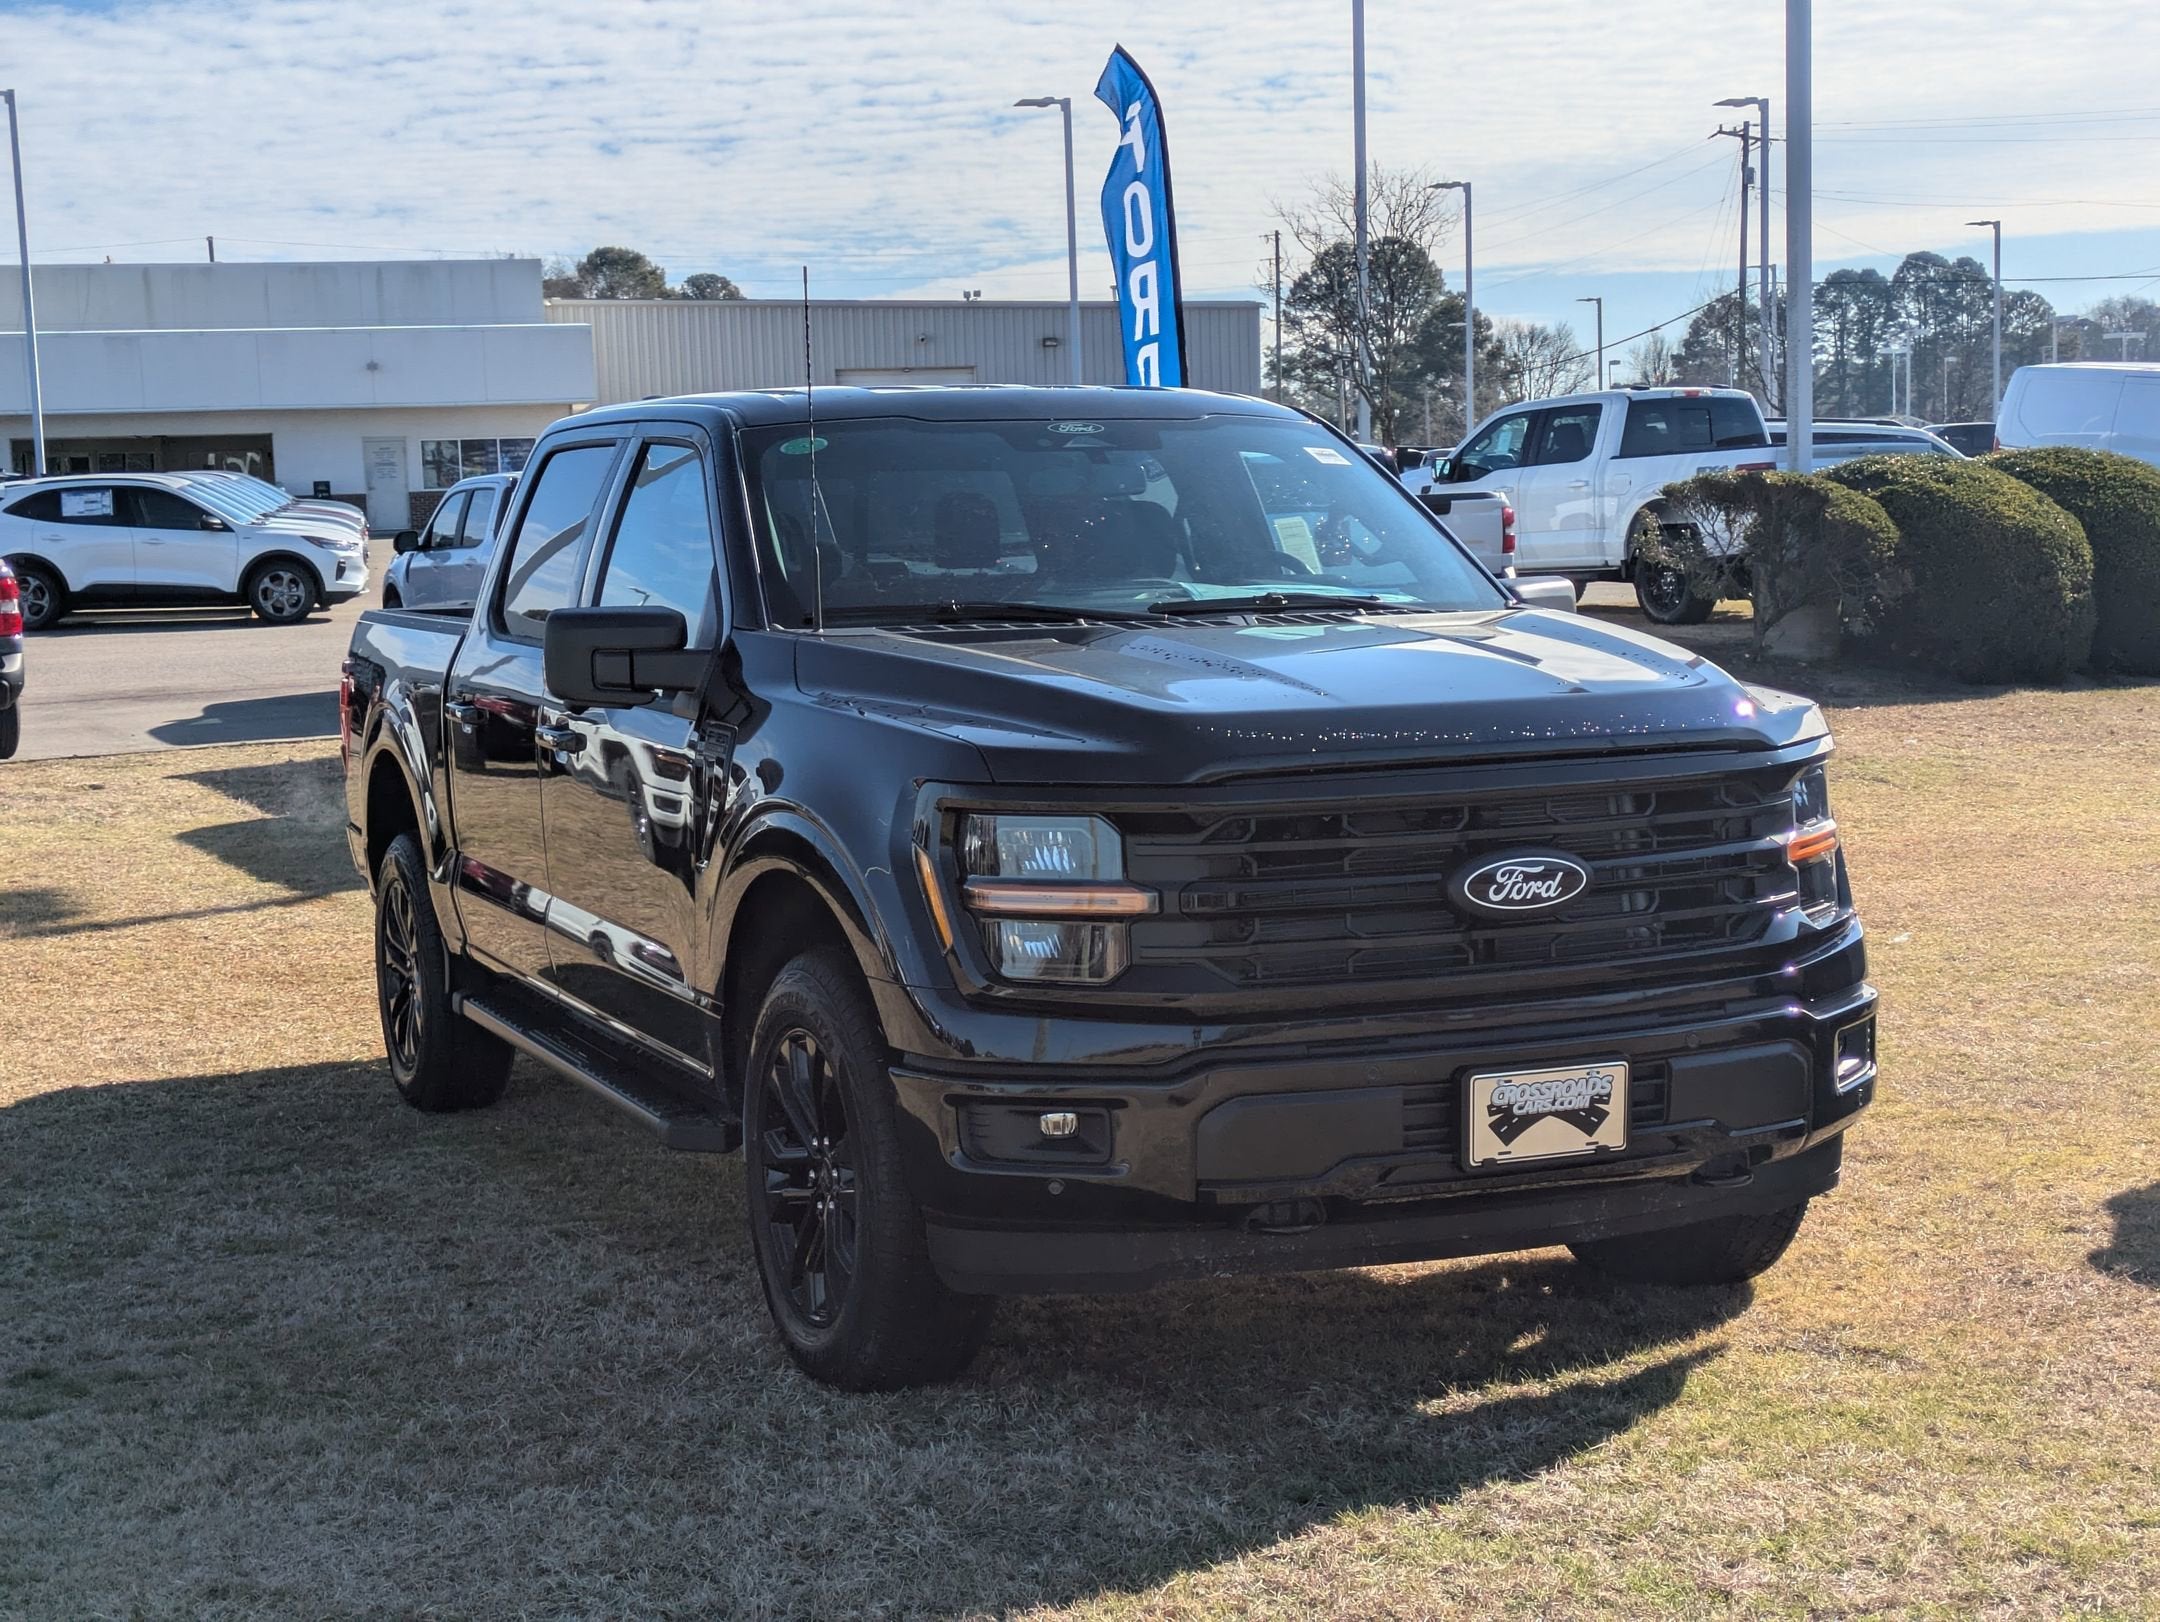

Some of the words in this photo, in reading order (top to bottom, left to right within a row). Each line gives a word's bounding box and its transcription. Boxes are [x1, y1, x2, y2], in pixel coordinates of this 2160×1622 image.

[1058, 423, 1096, 433] Ford
[1488, 865, 1564, 902] Ford
[1491, 1075, 1614, 1106] CROSSROADS
[1512, 1094, 1592, 1116] CARS.COM
